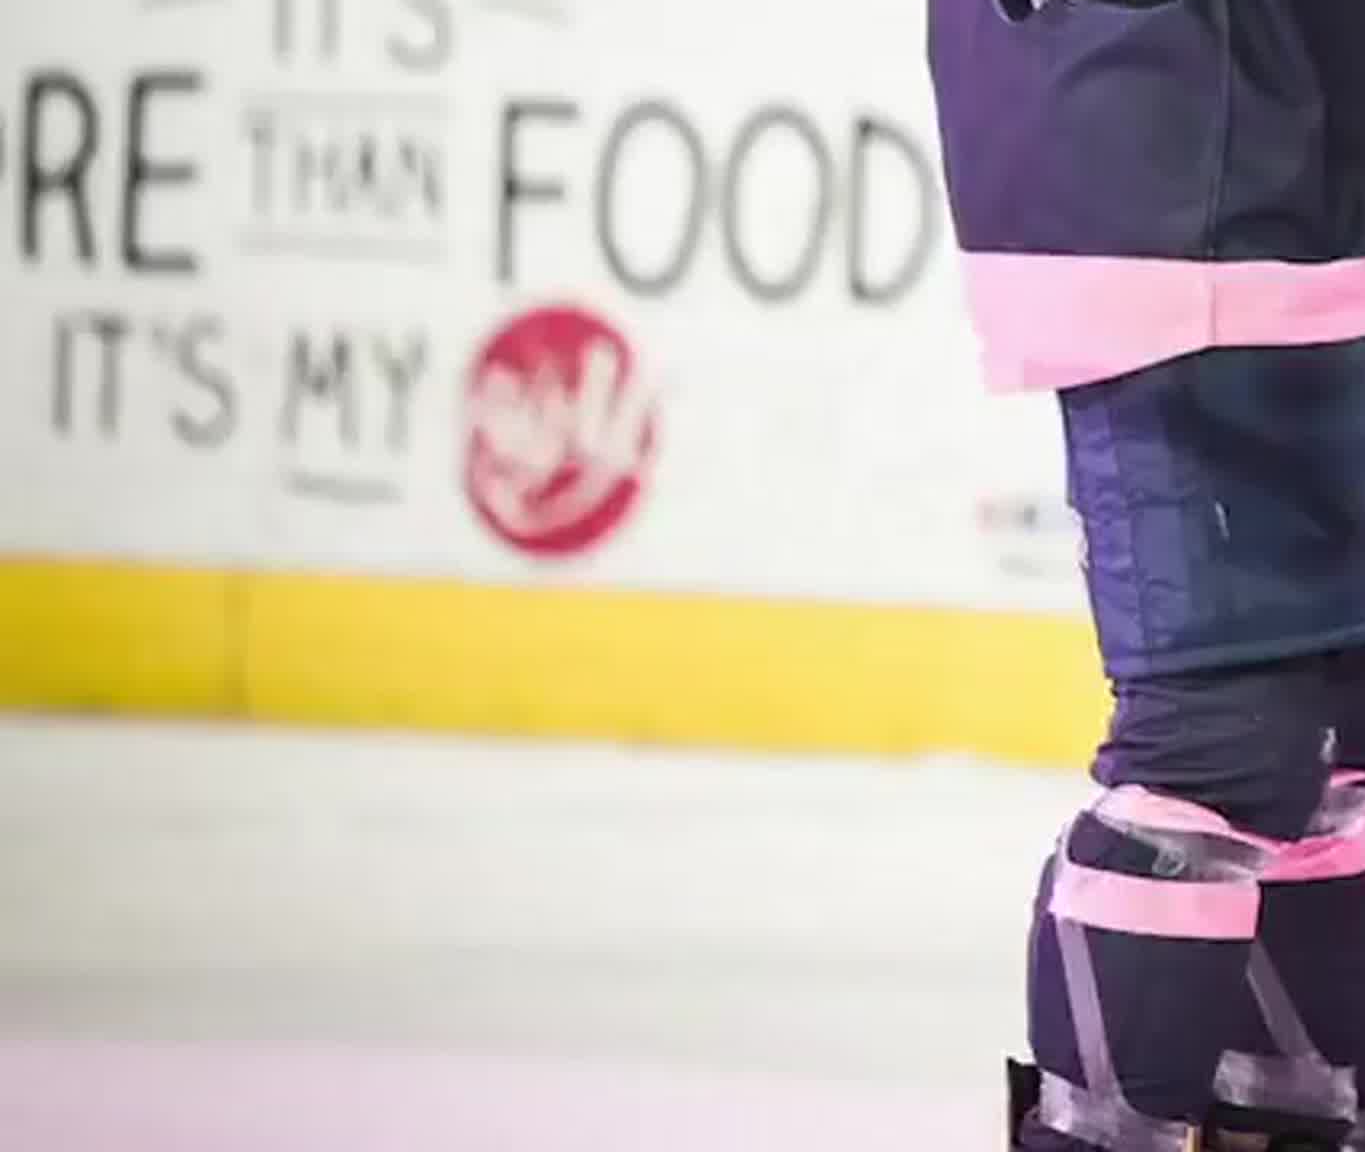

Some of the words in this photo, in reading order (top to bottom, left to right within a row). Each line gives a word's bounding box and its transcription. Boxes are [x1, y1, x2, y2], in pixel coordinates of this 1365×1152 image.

[0, 70, 208, 276] RE
[242, 108, 445, 222] THAN
[496, 98, 942, 305] FOOD
[50, 309, 236, 450] IT'S
[281, 326, 430, 452] MY
